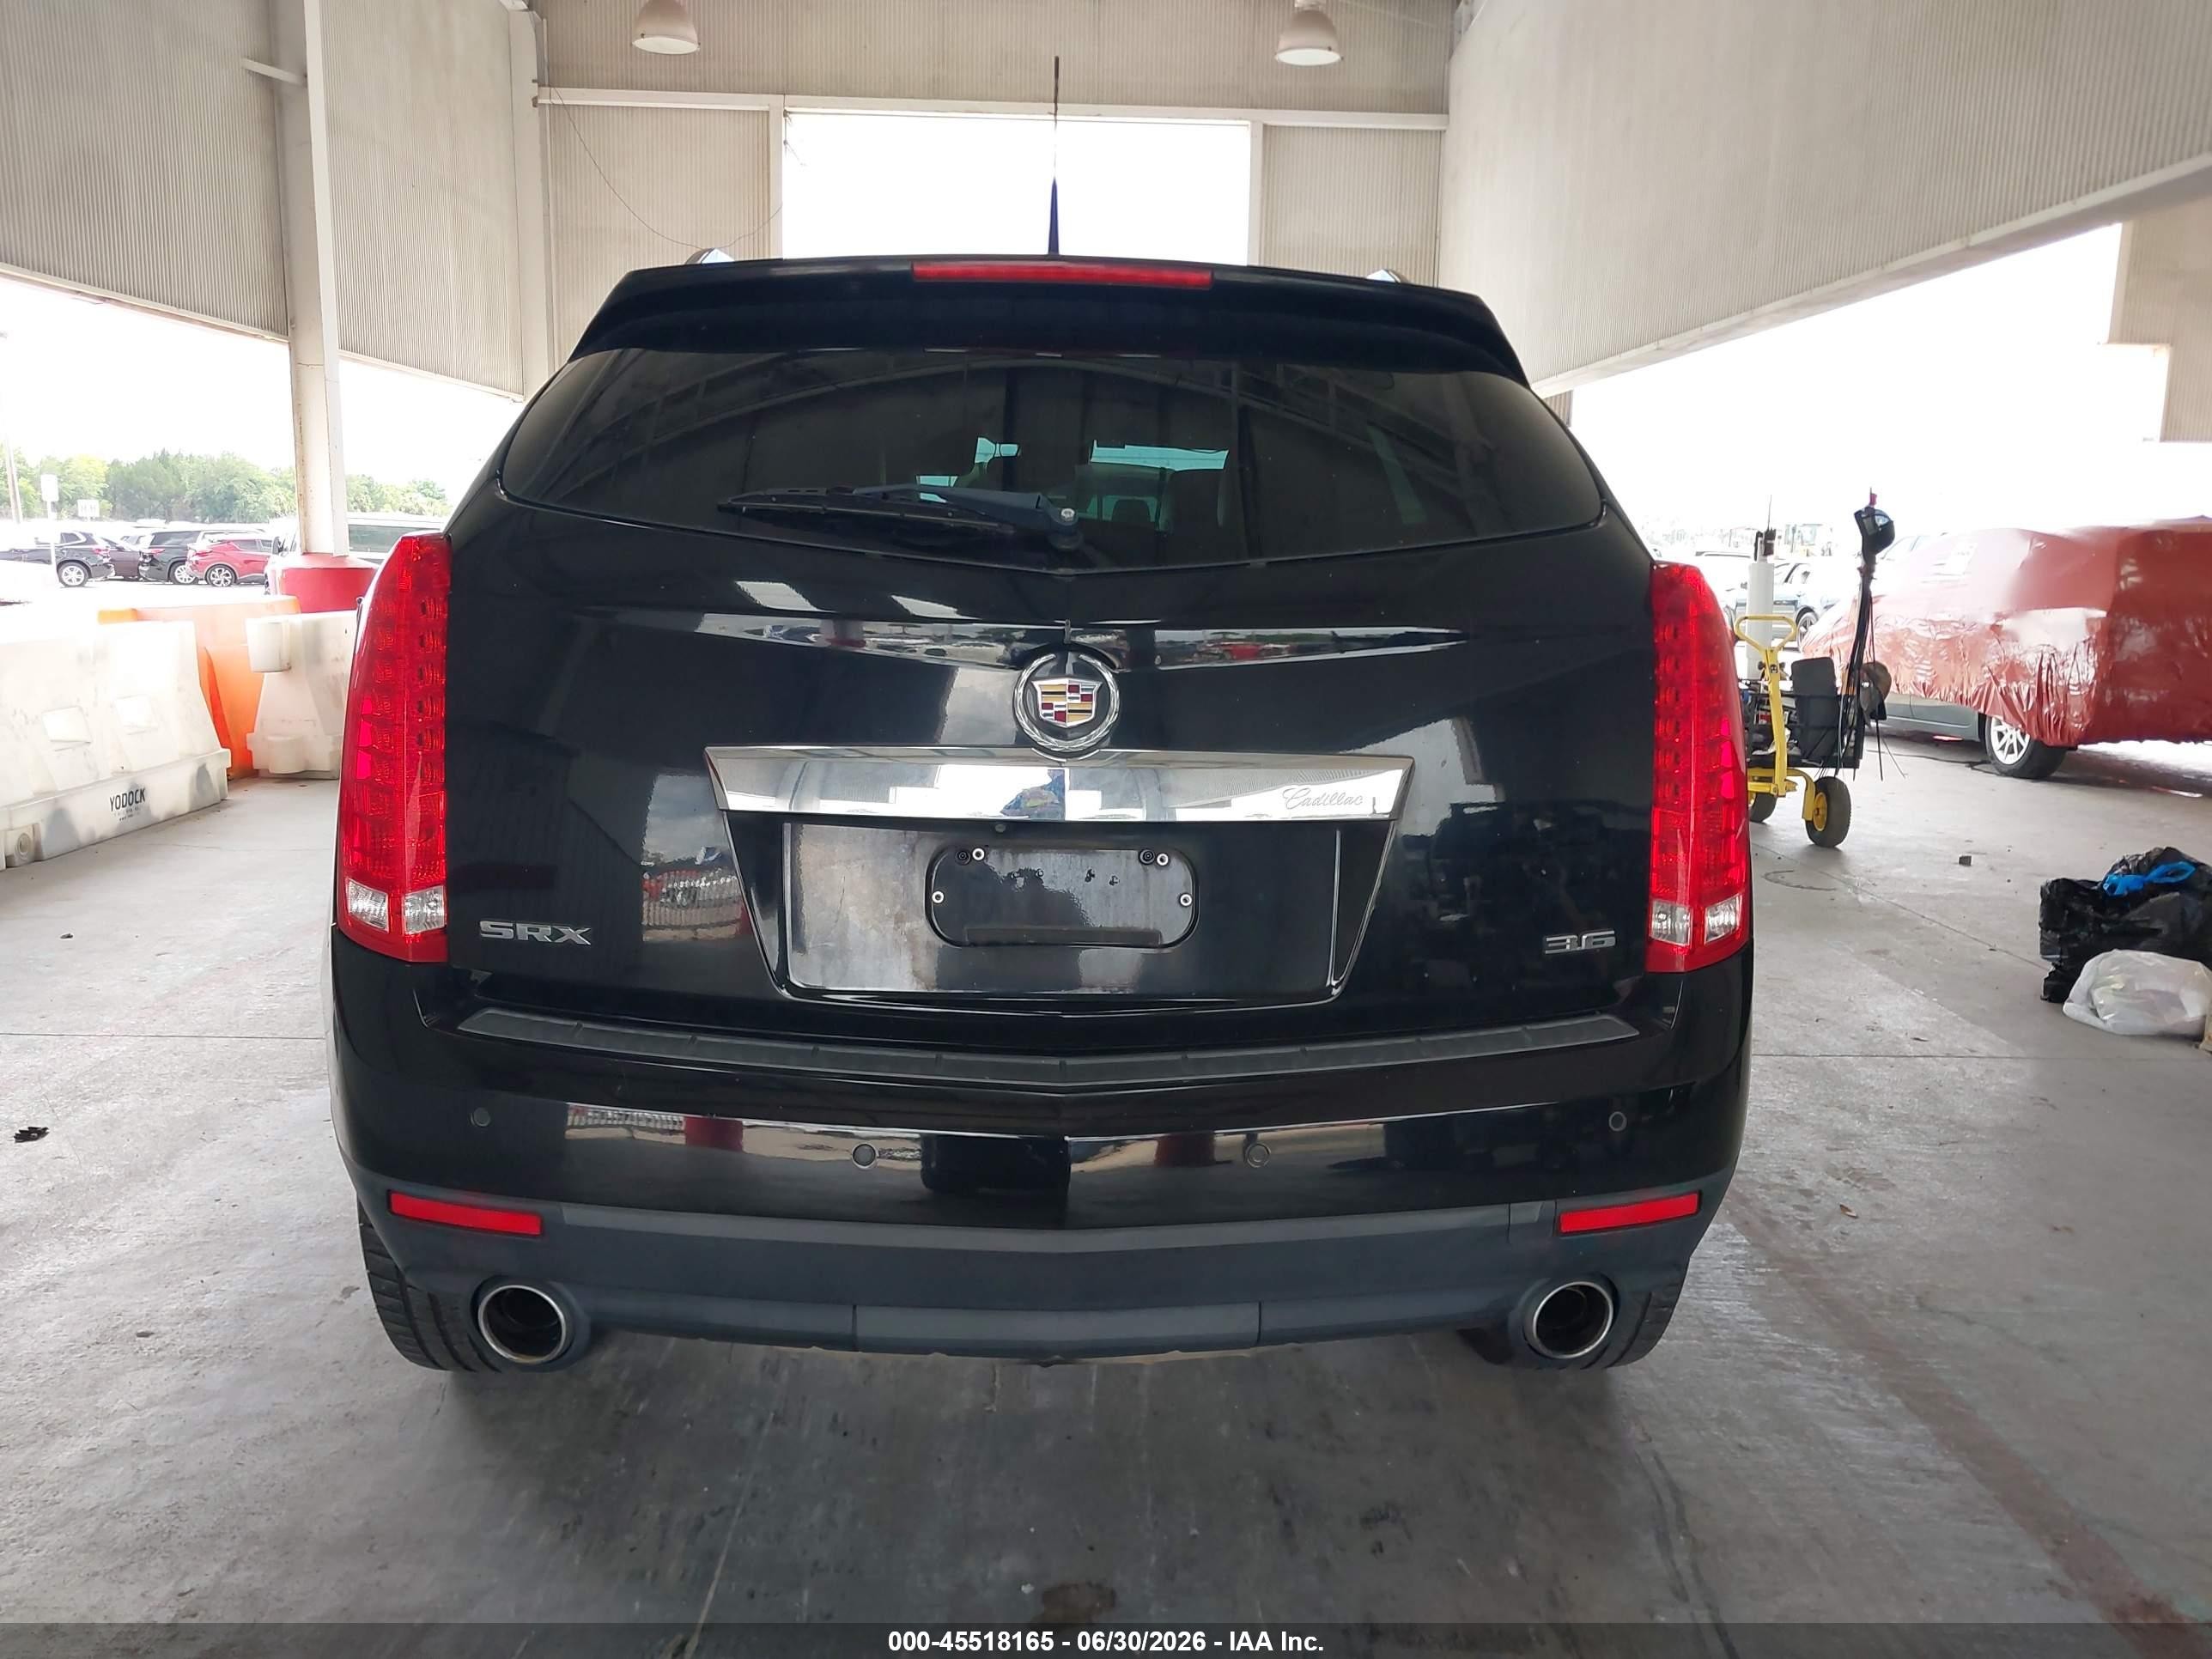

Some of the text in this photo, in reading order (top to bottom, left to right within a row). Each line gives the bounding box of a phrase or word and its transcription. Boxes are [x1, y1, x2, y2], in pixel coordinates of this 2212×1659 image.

[109, 787, 146, 811] YODOCK
[1282, 787, 1364, 810] Cadillac
[479, 921, 592, 945] SRX
